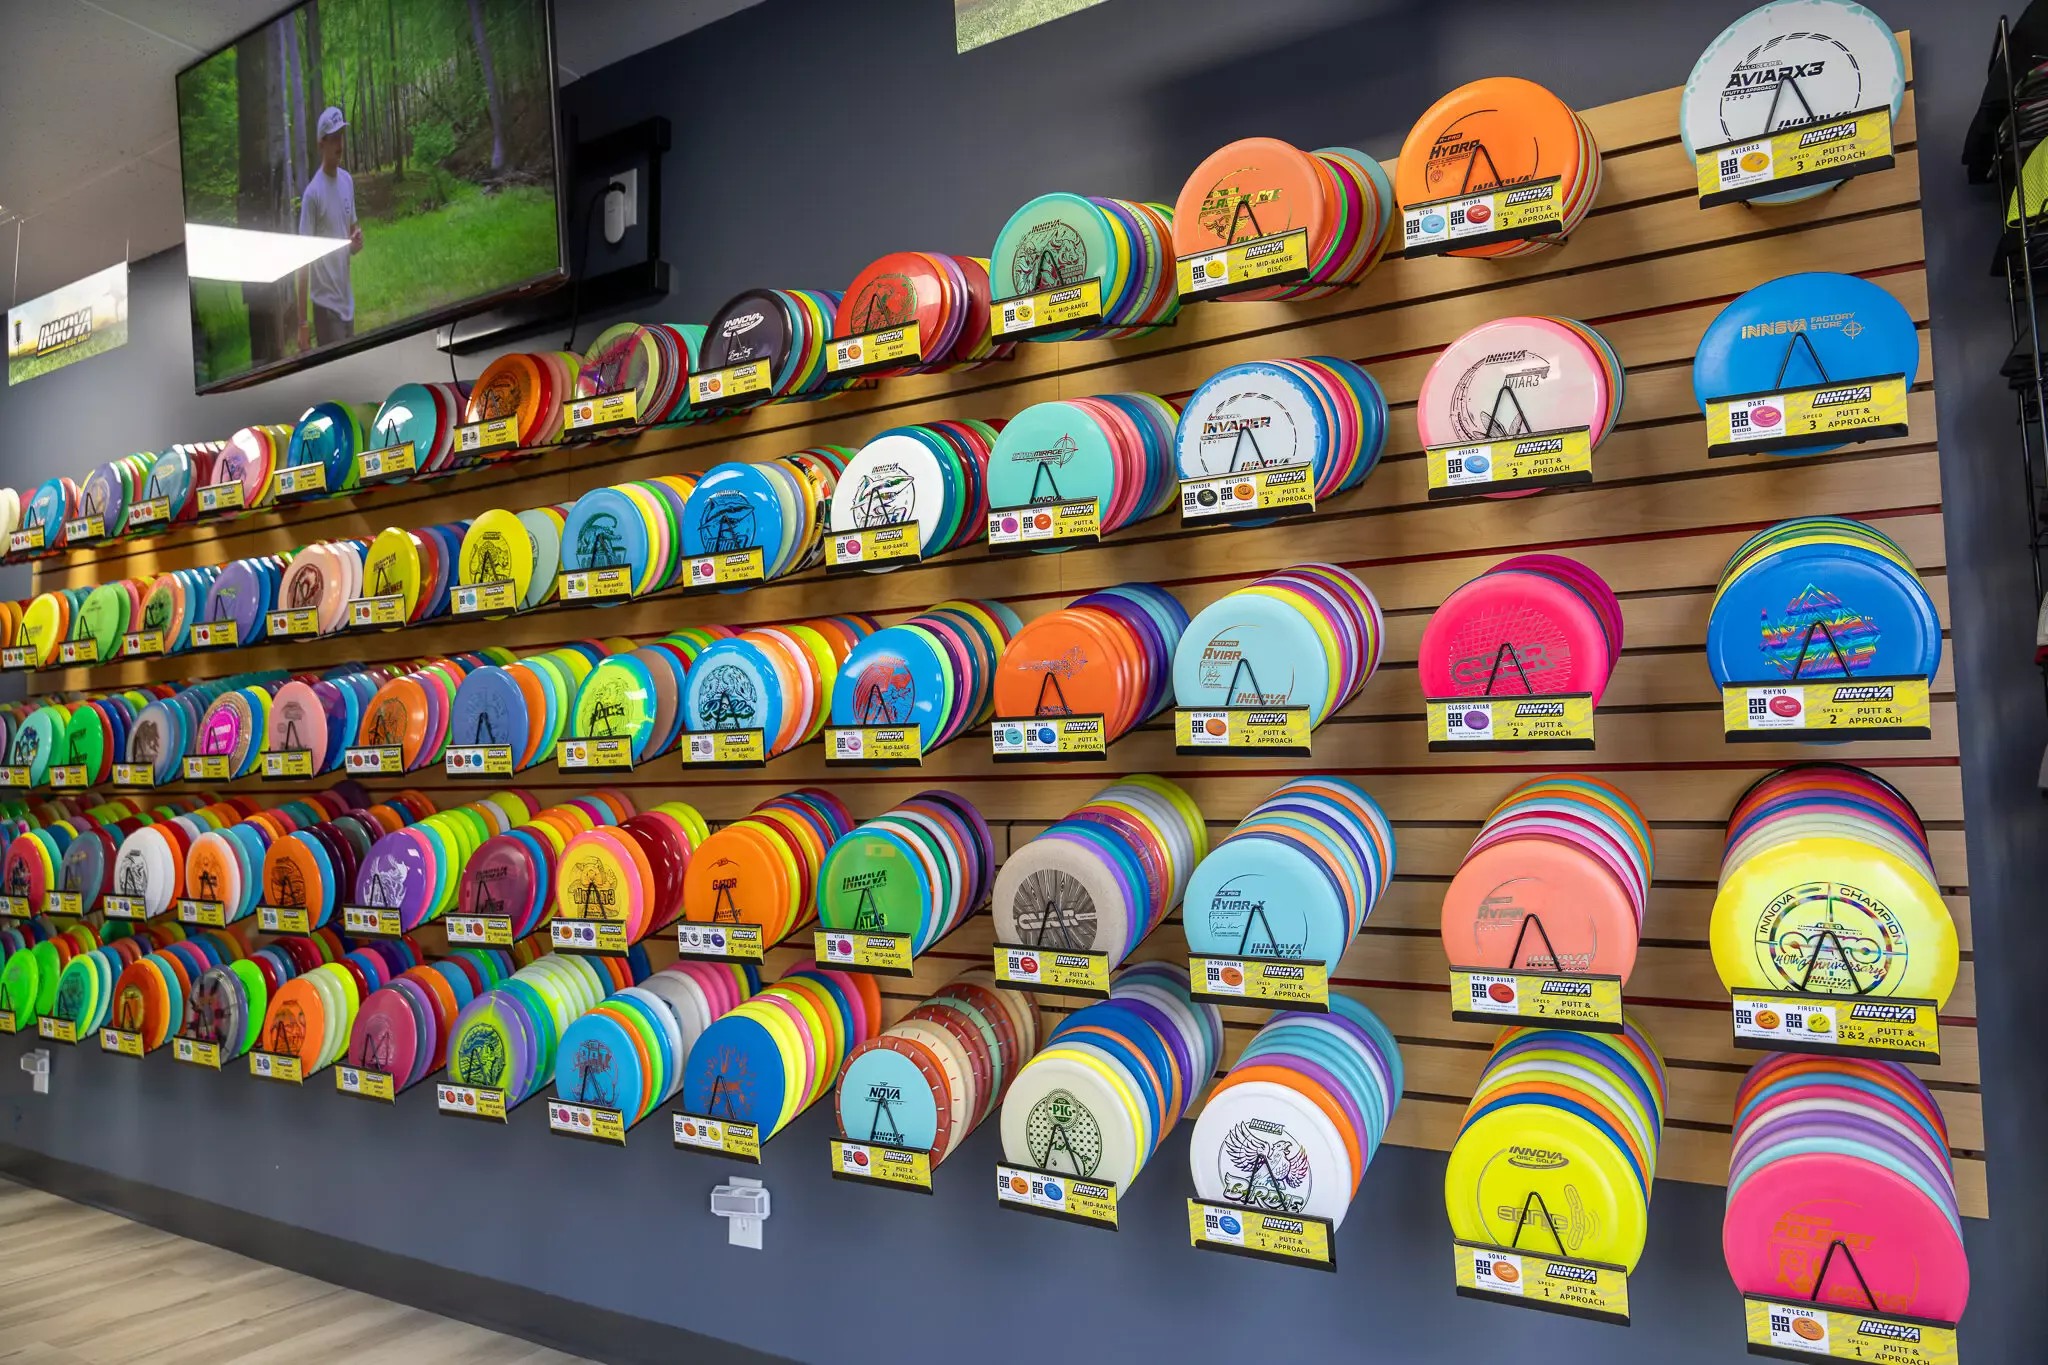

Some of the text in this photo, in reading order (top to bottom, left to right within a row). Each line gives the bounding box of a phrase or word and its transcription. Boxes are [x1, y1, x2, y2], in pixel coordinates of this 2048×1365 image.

[1725, 60, 1826, 89] AVIARX3
[1744, 84, 1777, 94] APPROACH
[1800, 121, 1857, 146] INNOVA
[1730, 143, 1760, 156] AVIARX3
[1822, 145, 1847, 156] PUTT
[1789, 152, 1810, 162] SPEED
[1815, 150, 1866, 168] APPROACH
[1796, 161, 1804, 172] 3
[1506, 186, 1552, 204] INNOVA
[1461, 199, 1481, 207] HYDRA
[1524, 207, 1543, 215] PUTT
[1502, 218, 1509, 227] 3
[1517, 211, 1560, 224] APPROACH
[1247, 241, 1284, 257] INNOVA
[1255, 255, 1293, 268] MID-RANGE
[1267, 265, 1283, 274] DISC
[1050, 289, 1081, 303] INNOVA
[1058, 302, 1089, 313] MID-RANGE
[724, 312, 761, 329] INNOVA
[1811, 312, 1856, 324] FACTORY
[38, 308, 92, 350] INNOVA
[1741, 318, 1807, 340] INNOVA
[1811, 320, 1842, 330] STORE
[1485, 350, 1528, 363] INNOVA
[1502, 375, 1540, 389] AVIAR3
[1814, 387, 1871, 404] INNOVA
[1747, 399, 1766, 407] DART
[1802, 412, 1823, 420] SPEED
[1836, 408, 1860, 417] PUTT
[1202, 416, 1272, 435] INVADER
[1809, 420, 1817, 431] 3
[1827, 415, 1881, 428] APPROACH
[1516, 438, 1562, 454] INNOVA
[1033, 448, 1063, 457] MIRAGE
[1512, 468, 1518, 477] 3
[1527, 464, 1570, 475] APPROACH
[1267, 471, 1306, 484] INNOVA
[1264, 496, 1269, 505] 3
[1276, 494, 1313, 504] APPROACH
[1061, 504, 1094, 516] INNOVA
[1202, 647, 1242, 661] AVIAR
[1236, 693, 1287, 705] INNOVA
[1835, 686, 1894, 700] INNOVA
[1517, 703, 1564, 714] INNOVA
[1248, 713, 1287, 723] INNOVA
[1830, 715, 1837, 724] 2
[1848, 716, 1902, 724] APPROACH
[1065, 721, 1098, 731] INNOVA
[1535, 721, 1555, 729] PUTT
[1512, 728, 1519, 737] 2
[1528, 729, 1572, 737] APPROACH
[1245, 735, 1250, 743] 2
[712, 878, 737, 890] GATOR
[842, 870, 887, 890] INNOVA
[1210, 898, 1266, 911] AVIAR-X
[1759, 893, 1796, 934] INNOVA
[1840, 887, 1903, 946] CHAMPION
[1250, 943, 1303, 955] INNOVA
[1056, 955, 1090, 967] INNOVA
[1526, 953, 1590, 968] INNOVA
[1264, 966, 1304, 978] INNOVA
[1064, 978, 1095, 986] APPROACH
[1542, 981, 1592, 994] INNOVA
[1261, 987, 1267, 995] 2
[1273, 990, 1311, 999] APPROACH
[1539, 1004, 1545, 1014] 2
[1561, 1000, 1582, 1008] PUTT
[1554, 1008, 1600, 1018] APPROACH
[1852, 1004, 1916, 1021] INNOVA
[1877, 1028, 1904, 1036] PUTT
[1868, 1037, 1926, 1048] APPROACH
[869, 1087, 900, 1100] NOVA
[1052, 1104, 1073, 1117] PIG
[1250, 1119, 1284, 1133] INNOVA
[1508, 1145, 1564, 1161] INNOVA
[1074, 1183, 1108, 1197] INNOVA
[1082, 1200, 1116, 1212] MID-RANGE
[1263, 1217, 1303, 1231] INNOVA
[1279, 1235, 1296, 1243] PUTT
[1773, 1221, 1877, 1249] POLECAT
[1273, 1243, 1311, 1254] APPROACH
[1487, 1253, 1507, 1261] SONIC
[1547, 1264, 1597, 1280] INNOVA
[1544, 1287, 1549, 1297] 1
[1566, 1285, 1588, 1294] PUTT
[1559, 1293, 1605, 1306] APPROACH
[1782, 1307, 1814, 1318] POLECAT
[1859, 1320, 1920, 1340] INNOVA
[1855, 1346, 1862, 1357] 1
[1883, 1344, 1909, 1354] PUTT
[1874, 1352, 1930, 1365] APPROACH
